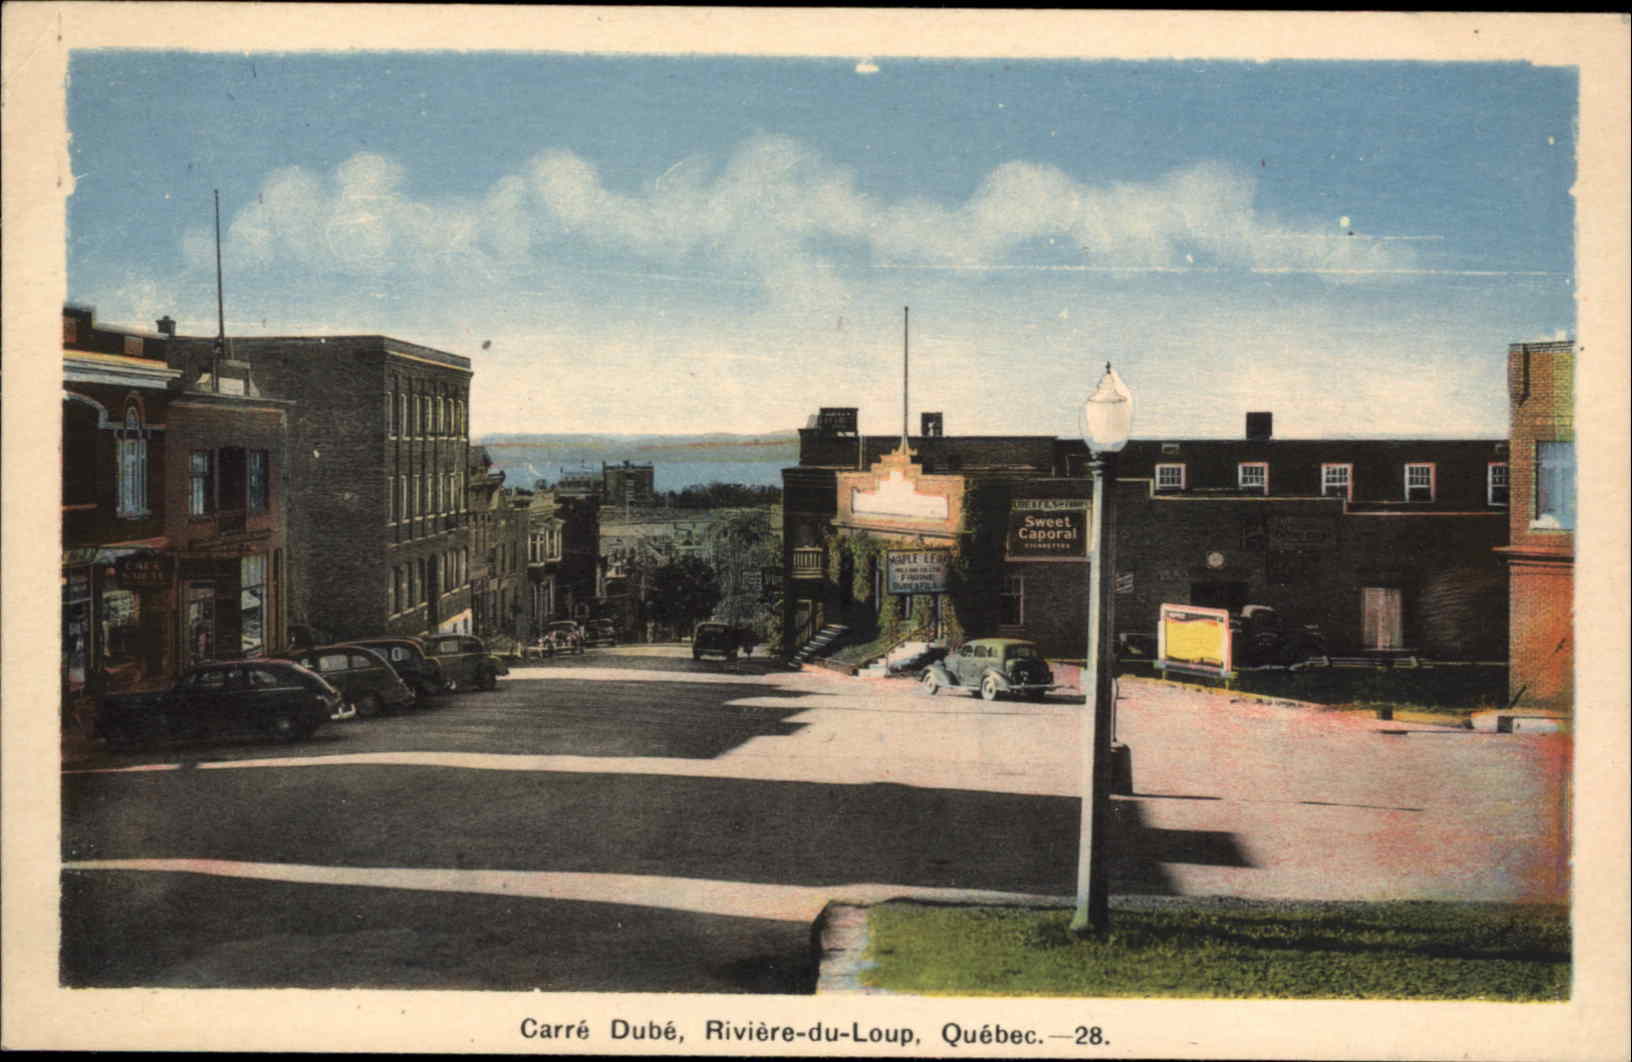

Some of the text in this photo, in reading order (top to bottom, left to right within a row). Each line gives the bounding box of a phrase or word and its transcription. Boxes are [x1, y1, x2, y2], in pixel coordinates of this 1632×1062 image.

[1025, 515, 1072, 528] Sweet
[1018, 528, 1077, 542] Caporal
[923, 552, 949, 564] LEA
